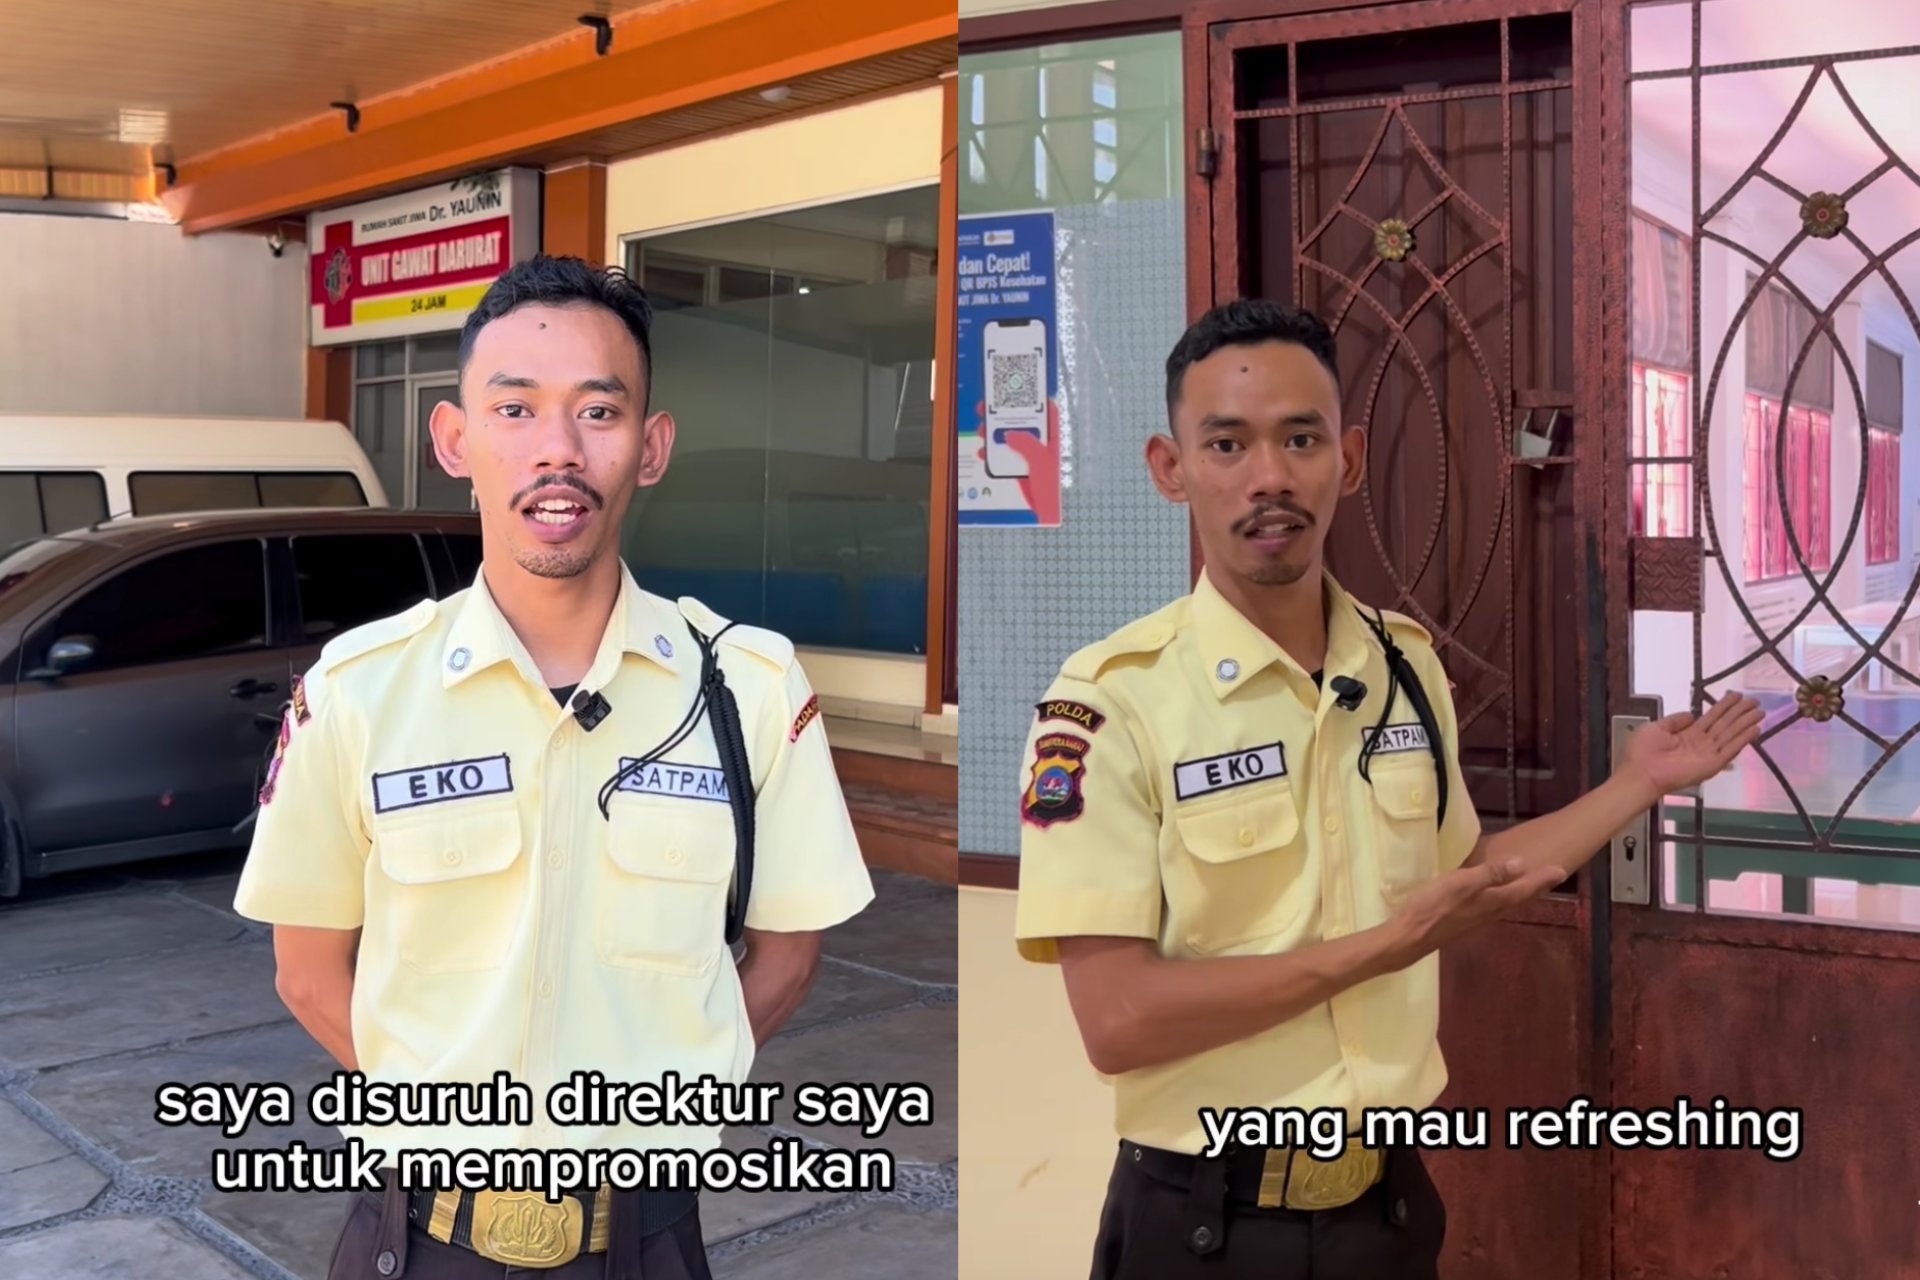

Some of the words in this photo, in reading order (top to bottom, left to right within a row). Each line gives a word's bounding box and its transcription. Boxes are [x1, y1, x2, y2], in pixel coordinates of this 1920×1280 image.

[429, 205, 447, 221] Dr.
[450, 191, 502, 217] YAUNIN
[361, 253, 390, 286] UNIT
[392, 243, 436, 281] GAWAT
[438, 231, 502, 273] DARURAT
[958, 255, 983, 275] dan
[986, 251, 1031, 276] Cepat!
[961, 277, 973, 291] QR
[976, 275, 998, 290] BPJS
[1000, 274, 1046, 288] Kesehatan
[411, 300, 422, 312] 24
[424, 295, 447, 310] JAM
[1047, 702, 1093, 727] POLDA
[631, 762, 726, 797] SATPAM
